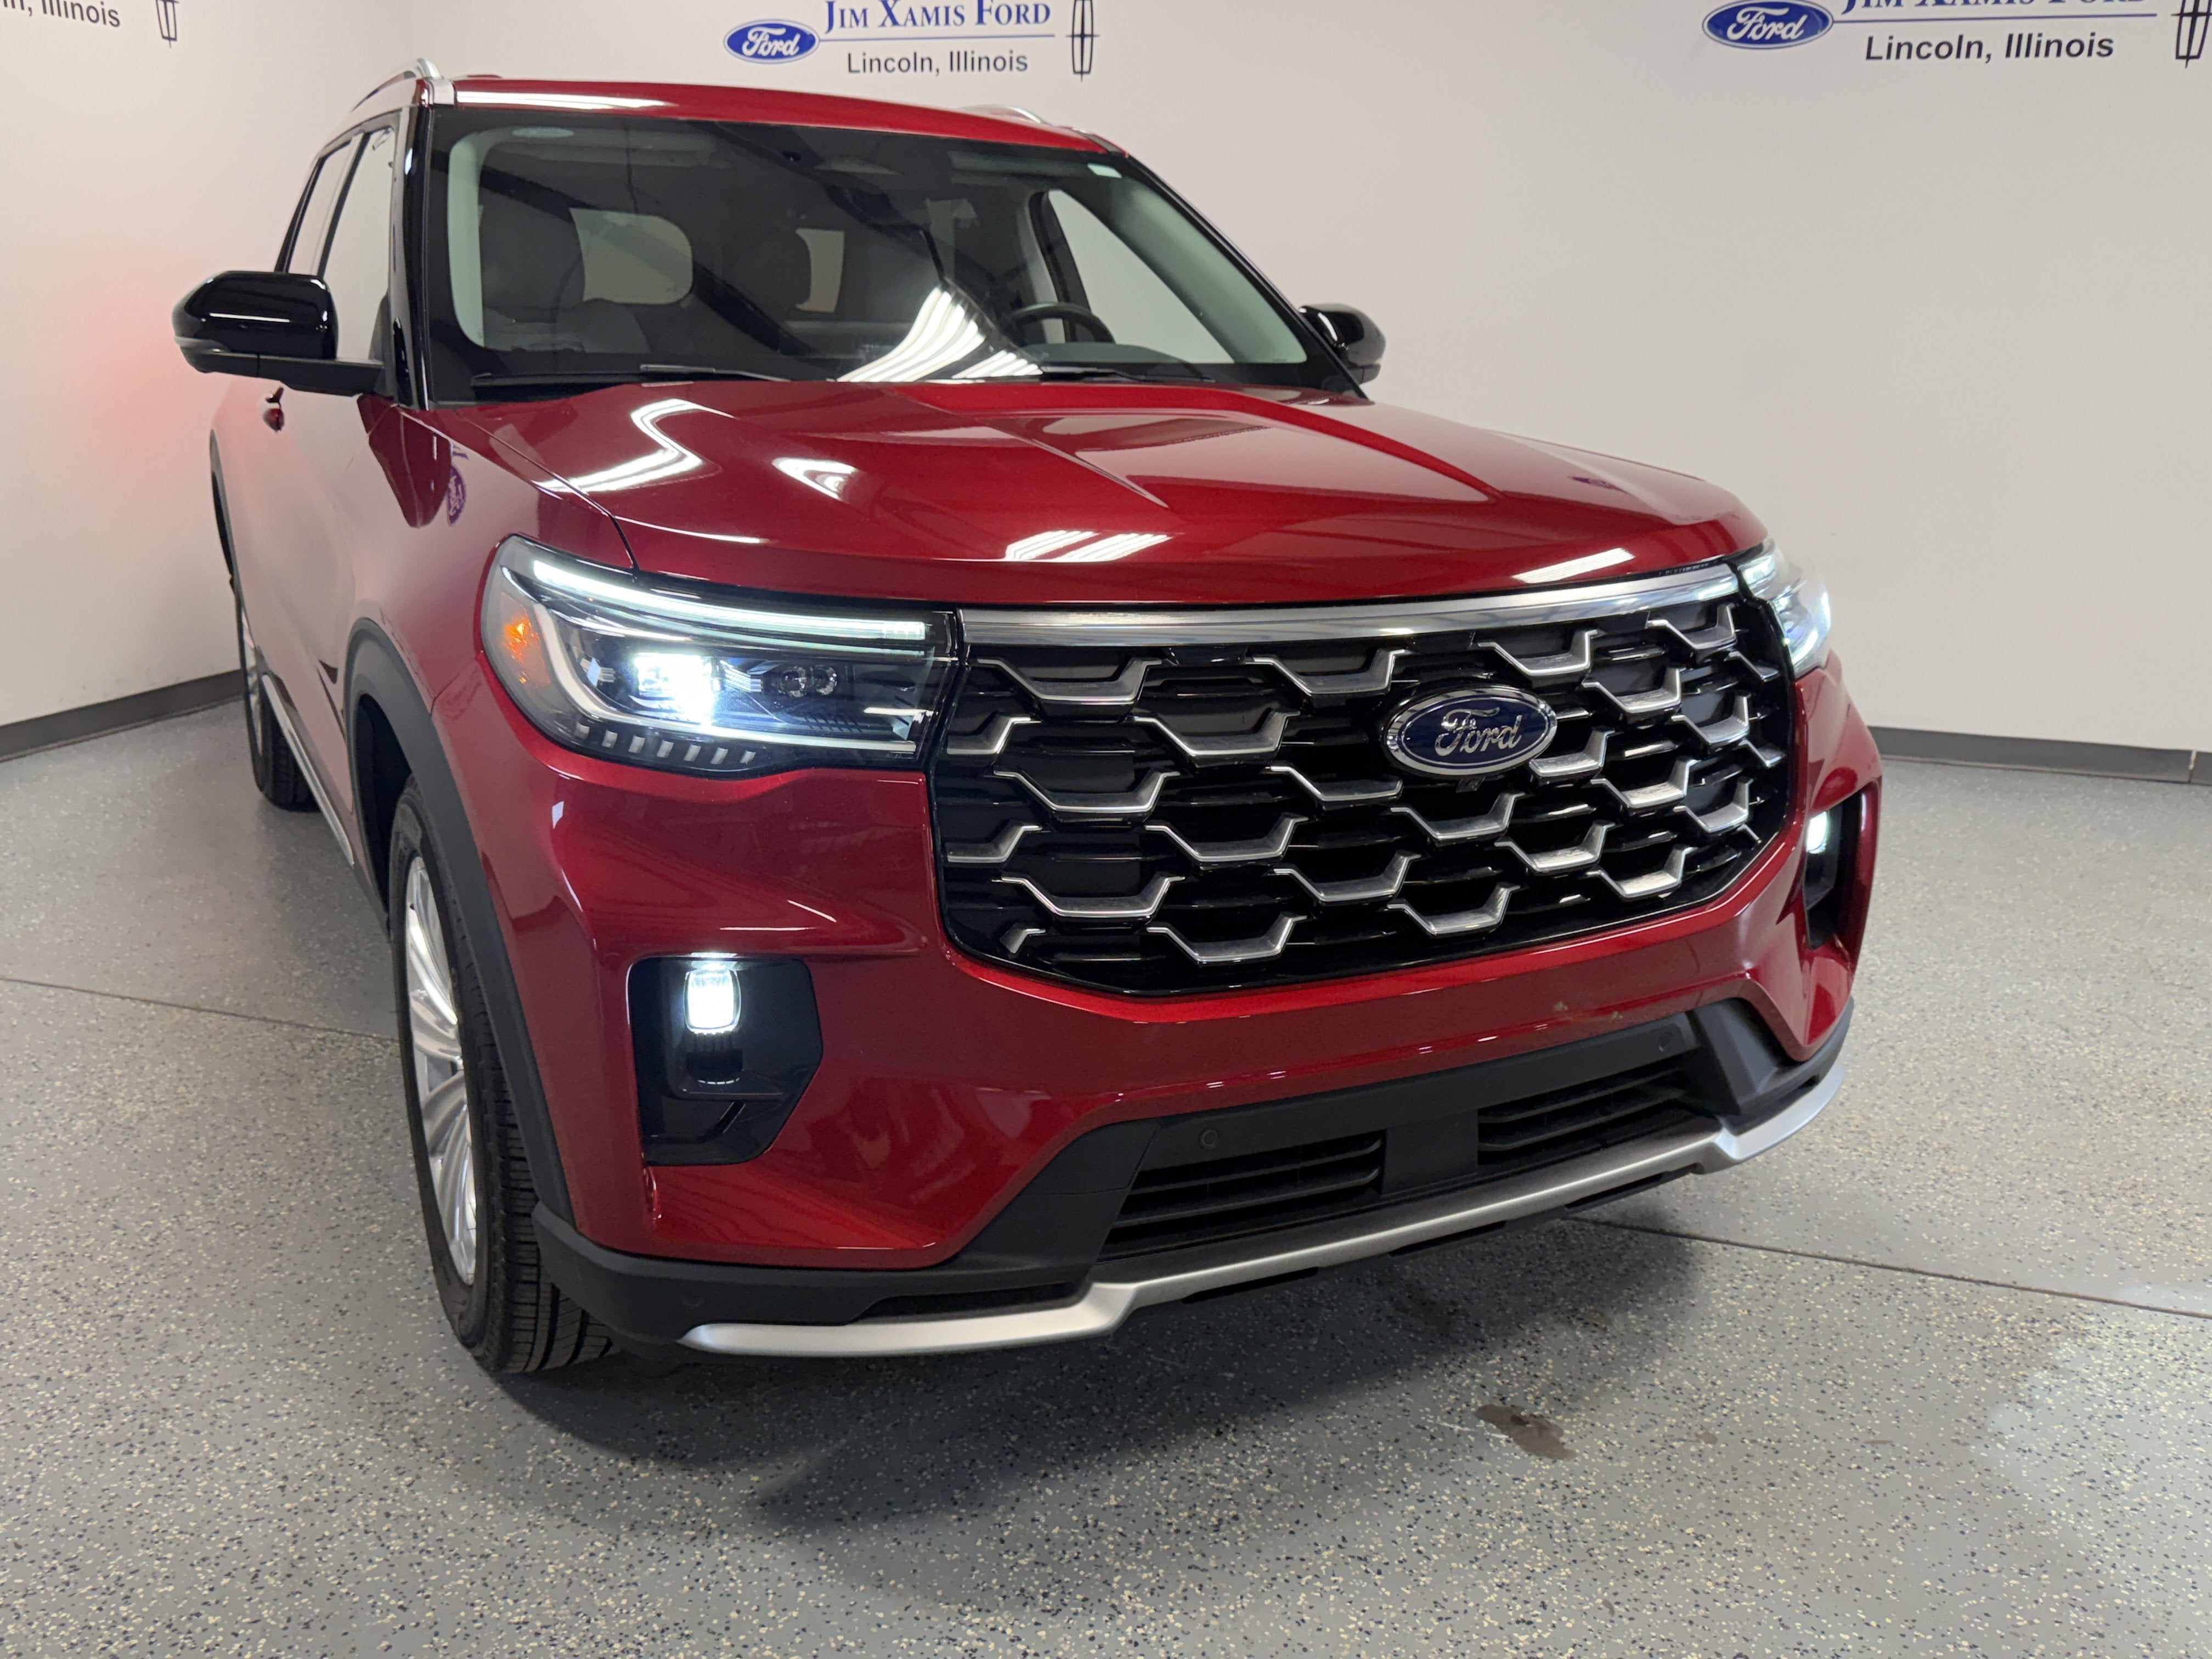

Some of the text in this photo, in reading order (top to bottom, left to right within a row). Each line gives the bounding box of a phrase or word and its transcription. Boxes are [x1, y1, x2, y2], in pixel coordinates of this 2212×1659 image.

[42, 0, 120, 27] Illinois
[825, 0, 1051, 34] JIM XAMIS FORD
[1726, 6, 1808, 41] Ford
[742, 27, 801, 57] Ford
[1865, 32, 2114, 64] Lincoln, Illinois
[848, 50, 1028, 77] Lincoln, Illinois
[1435, 706, 1522, 757] Ford
